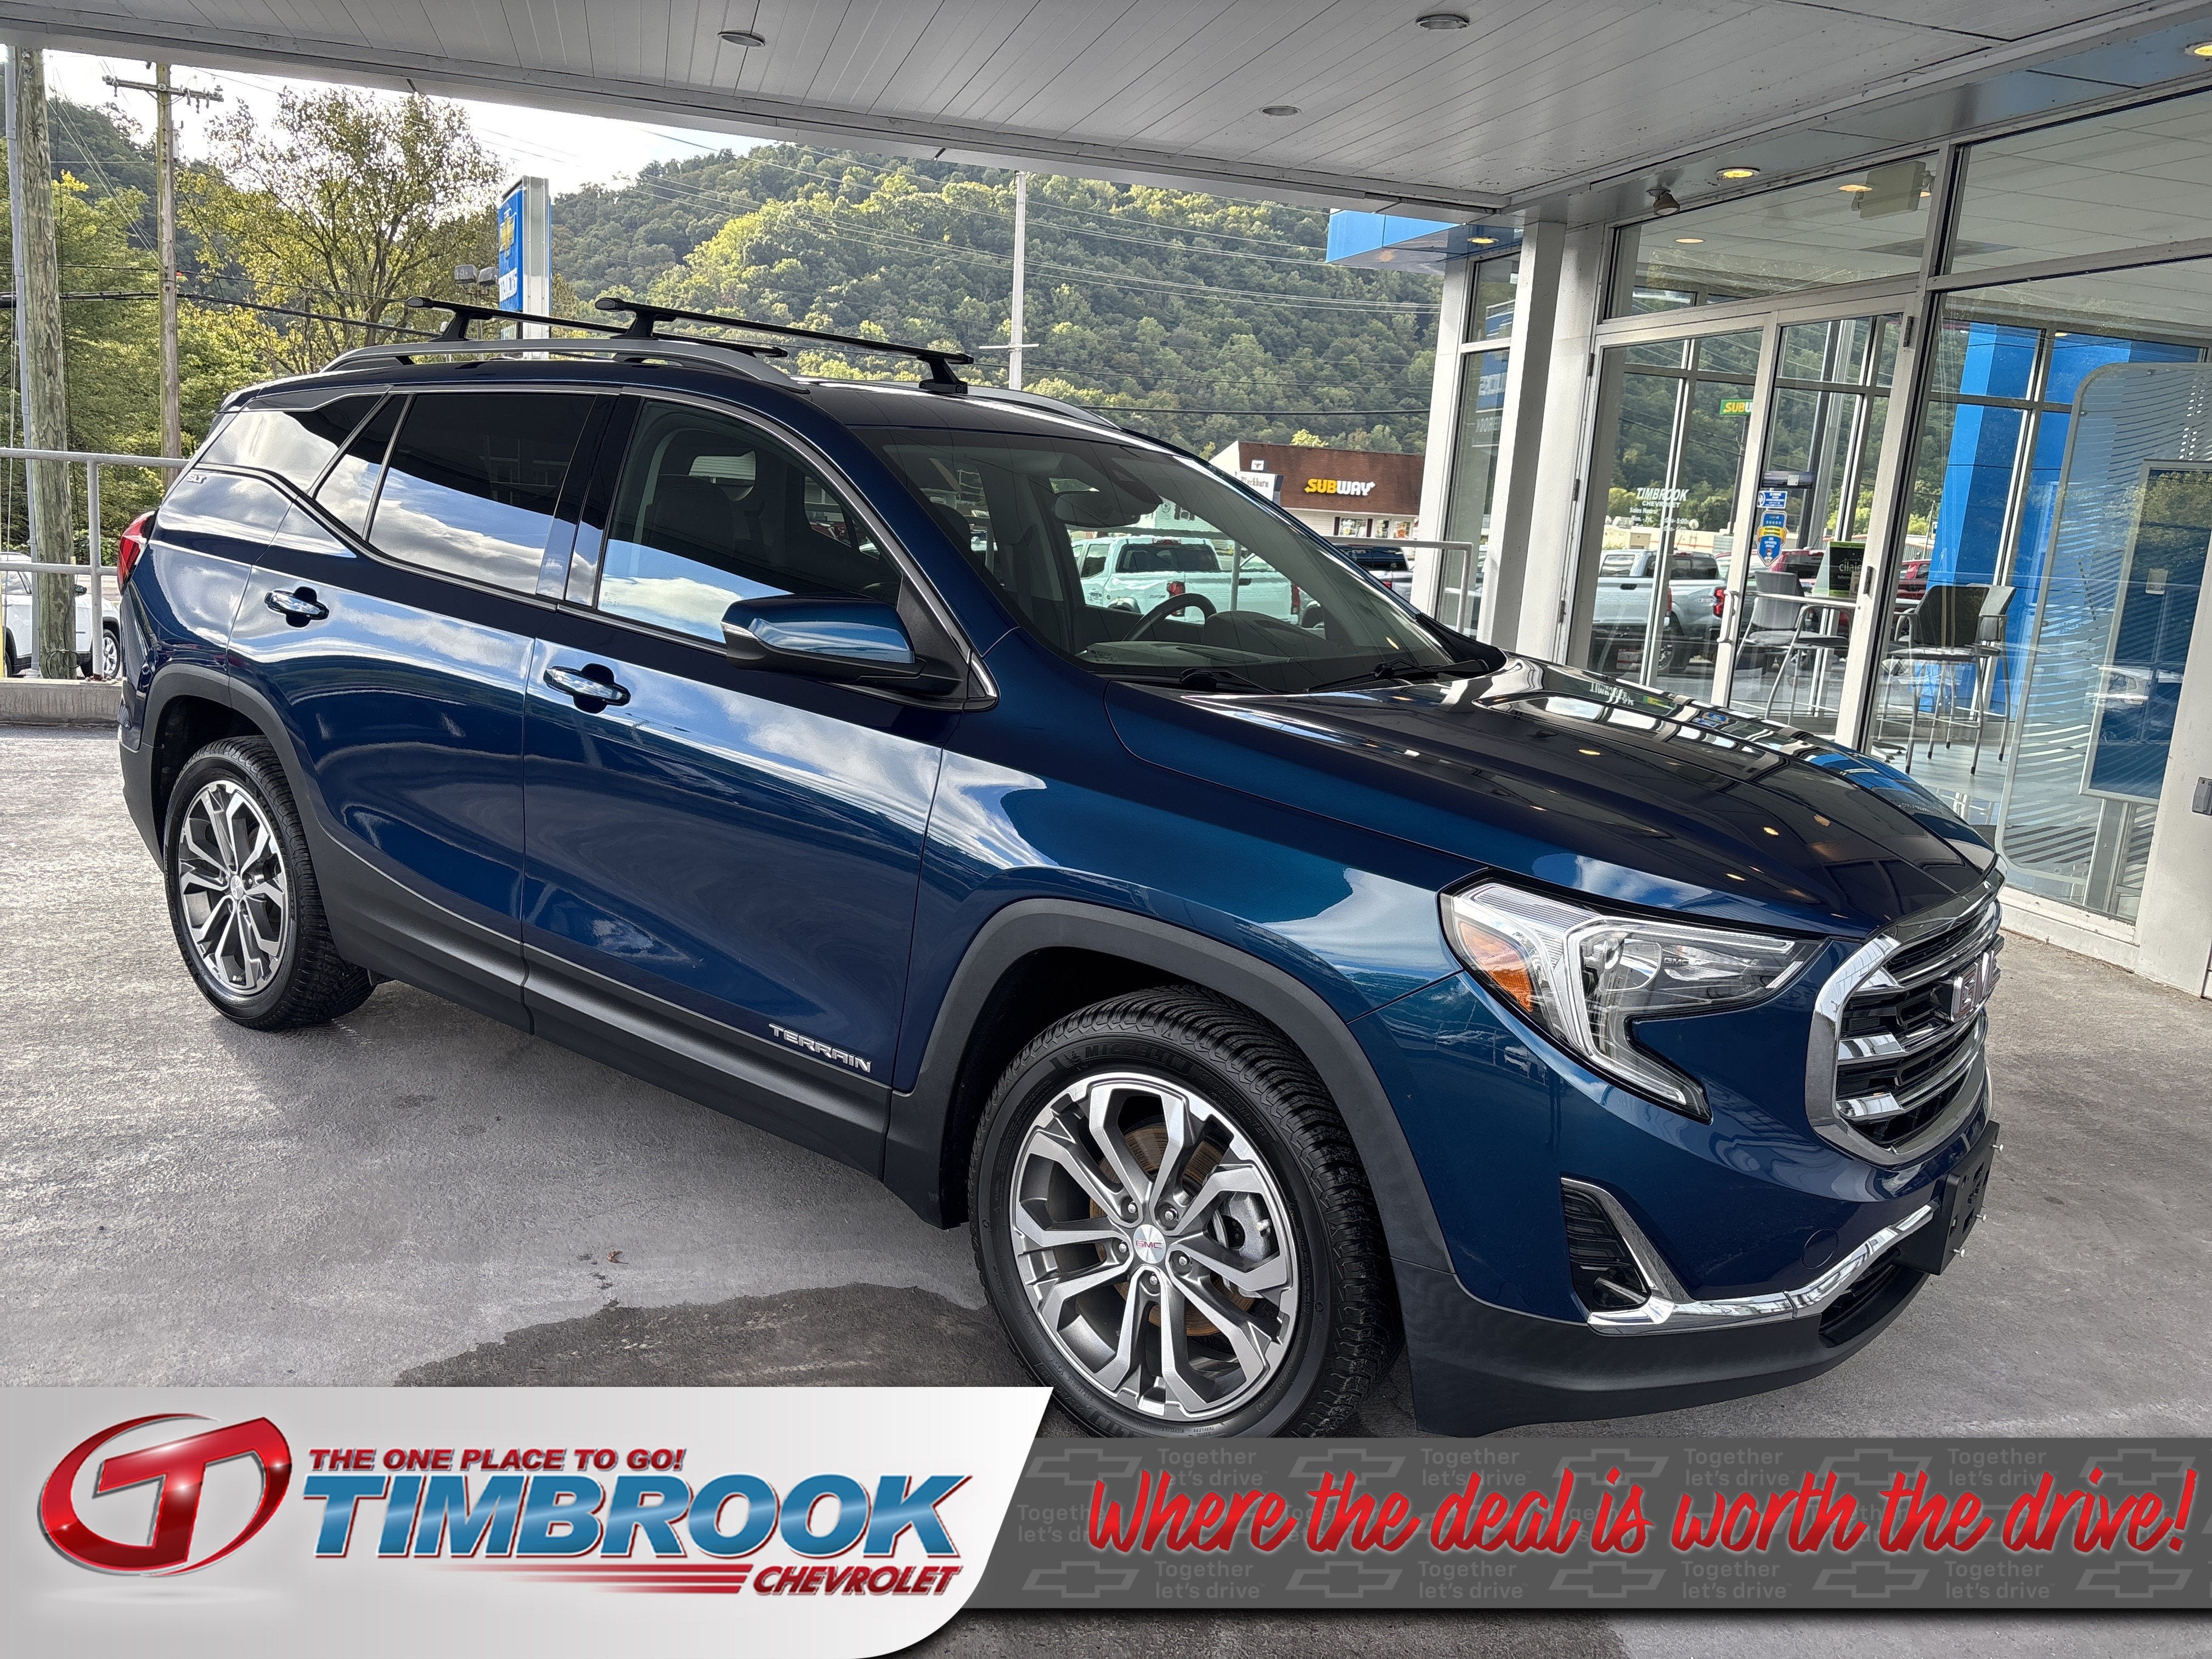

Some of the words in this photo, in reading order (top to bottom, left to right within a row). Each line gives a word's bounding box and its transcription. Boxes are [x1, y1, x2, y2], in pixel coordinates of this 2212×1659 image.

[1304, 478, 1376, 496] SUBWAY
[1664, 957, 1689, 966] GMC
[769, 1023, 872, 1074] TERRAIN
[1135, 1240, 1163, 1249] GMC
